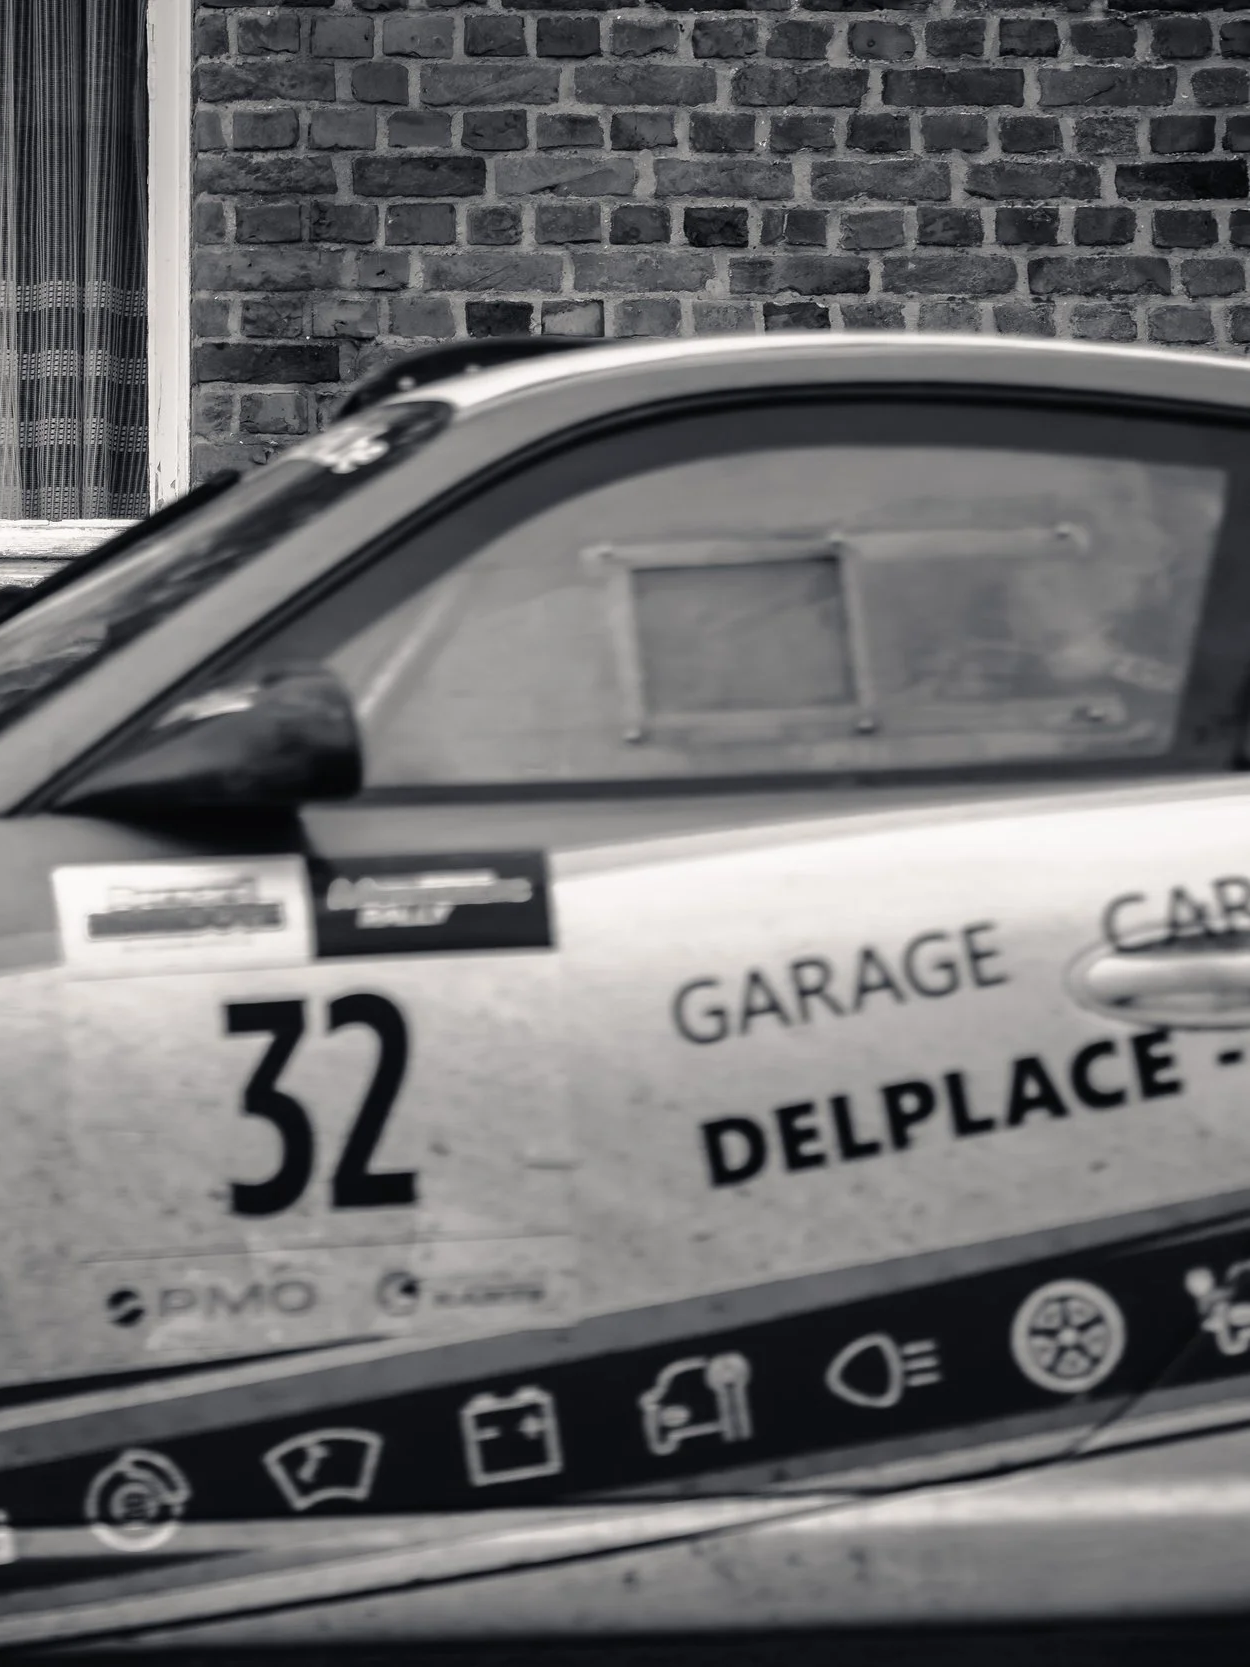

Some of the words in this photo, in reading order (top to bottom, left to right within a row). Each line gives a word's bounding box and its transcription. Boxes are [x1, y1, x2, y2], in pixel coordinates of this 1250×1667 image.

[671, 920, 1012, 1046] GARAGE
[225, 992, 419, 1217] 32
[700, 1025, 1184, 1189] DELPLACE
[157, 1280, 318, 1318] PMO
